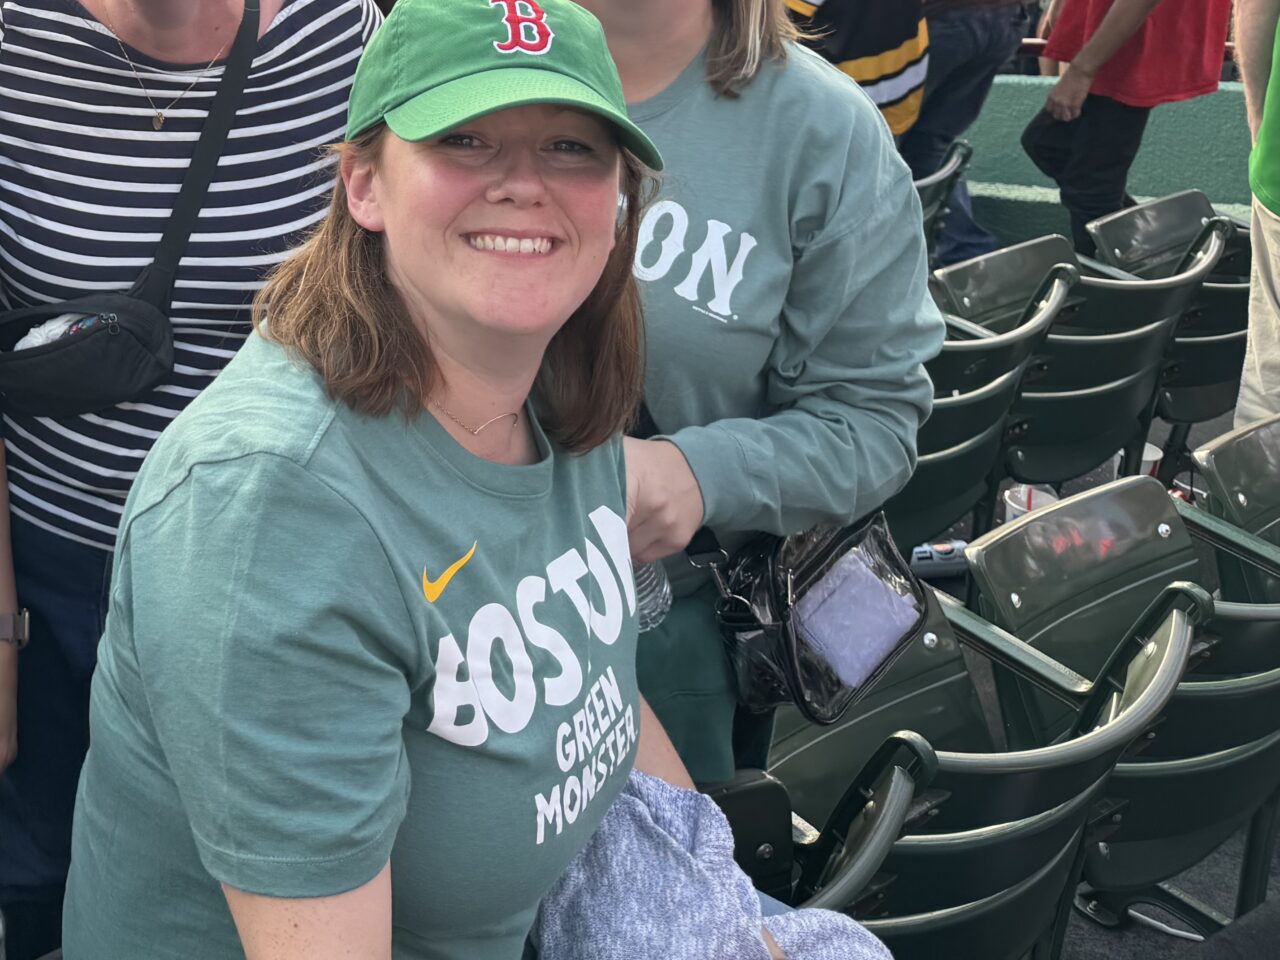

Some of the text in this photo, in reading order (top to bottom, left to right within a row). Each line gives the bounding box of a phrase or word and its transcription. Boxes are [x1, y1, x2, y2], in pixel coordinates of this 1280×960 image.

[628, 199, 758, 316] ON
[534, 704, 636, 845] MONSTER
[556, 666, 623, 773] GREEN
